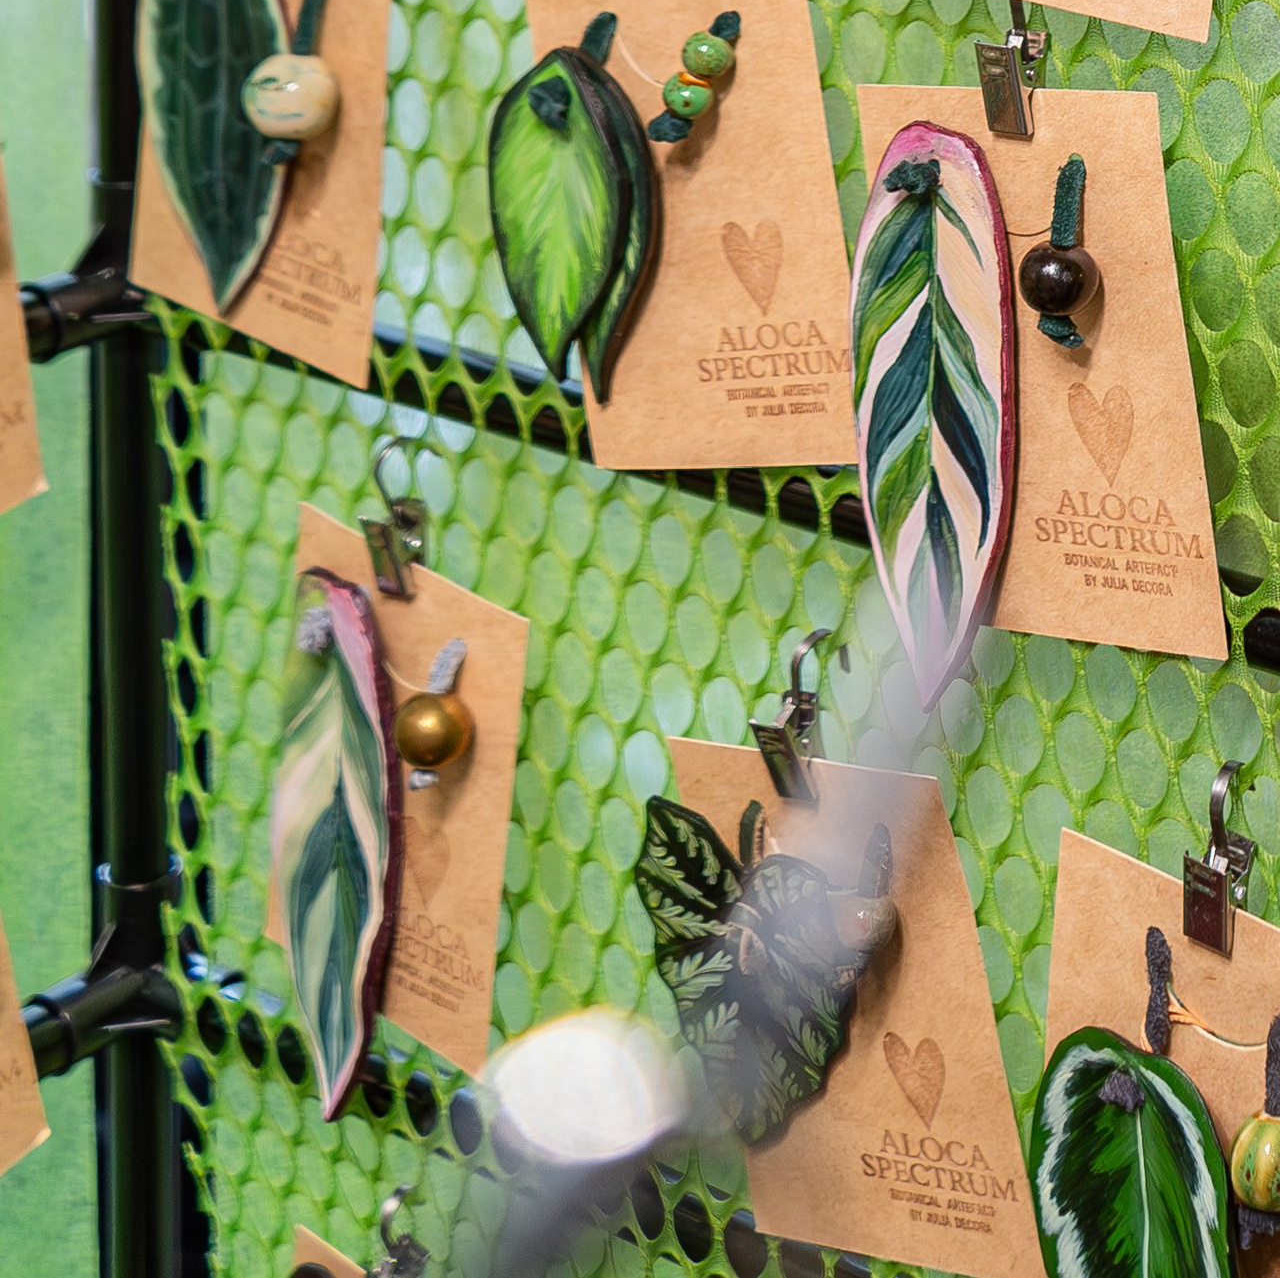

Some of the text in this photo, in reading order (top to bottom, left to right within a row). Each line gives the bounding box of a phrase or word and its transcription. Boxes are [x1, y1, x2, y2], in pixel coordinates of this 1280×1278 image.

[716, 320, 828, 352] ALOCA
[698, 349, 851, 382] SPECTRUM
[1057, 490, 1177, 527] ALOCA
[1035, 517, 1204, 559] SPECTRUM
[1064, 553, 1118, 570] BOTANICAL
[1101, 576, 1128, 591] JULIA
[880, 1130, 994, 1171] ALOCA
[861, 1153, 1019, 1202] SPECTRUM
